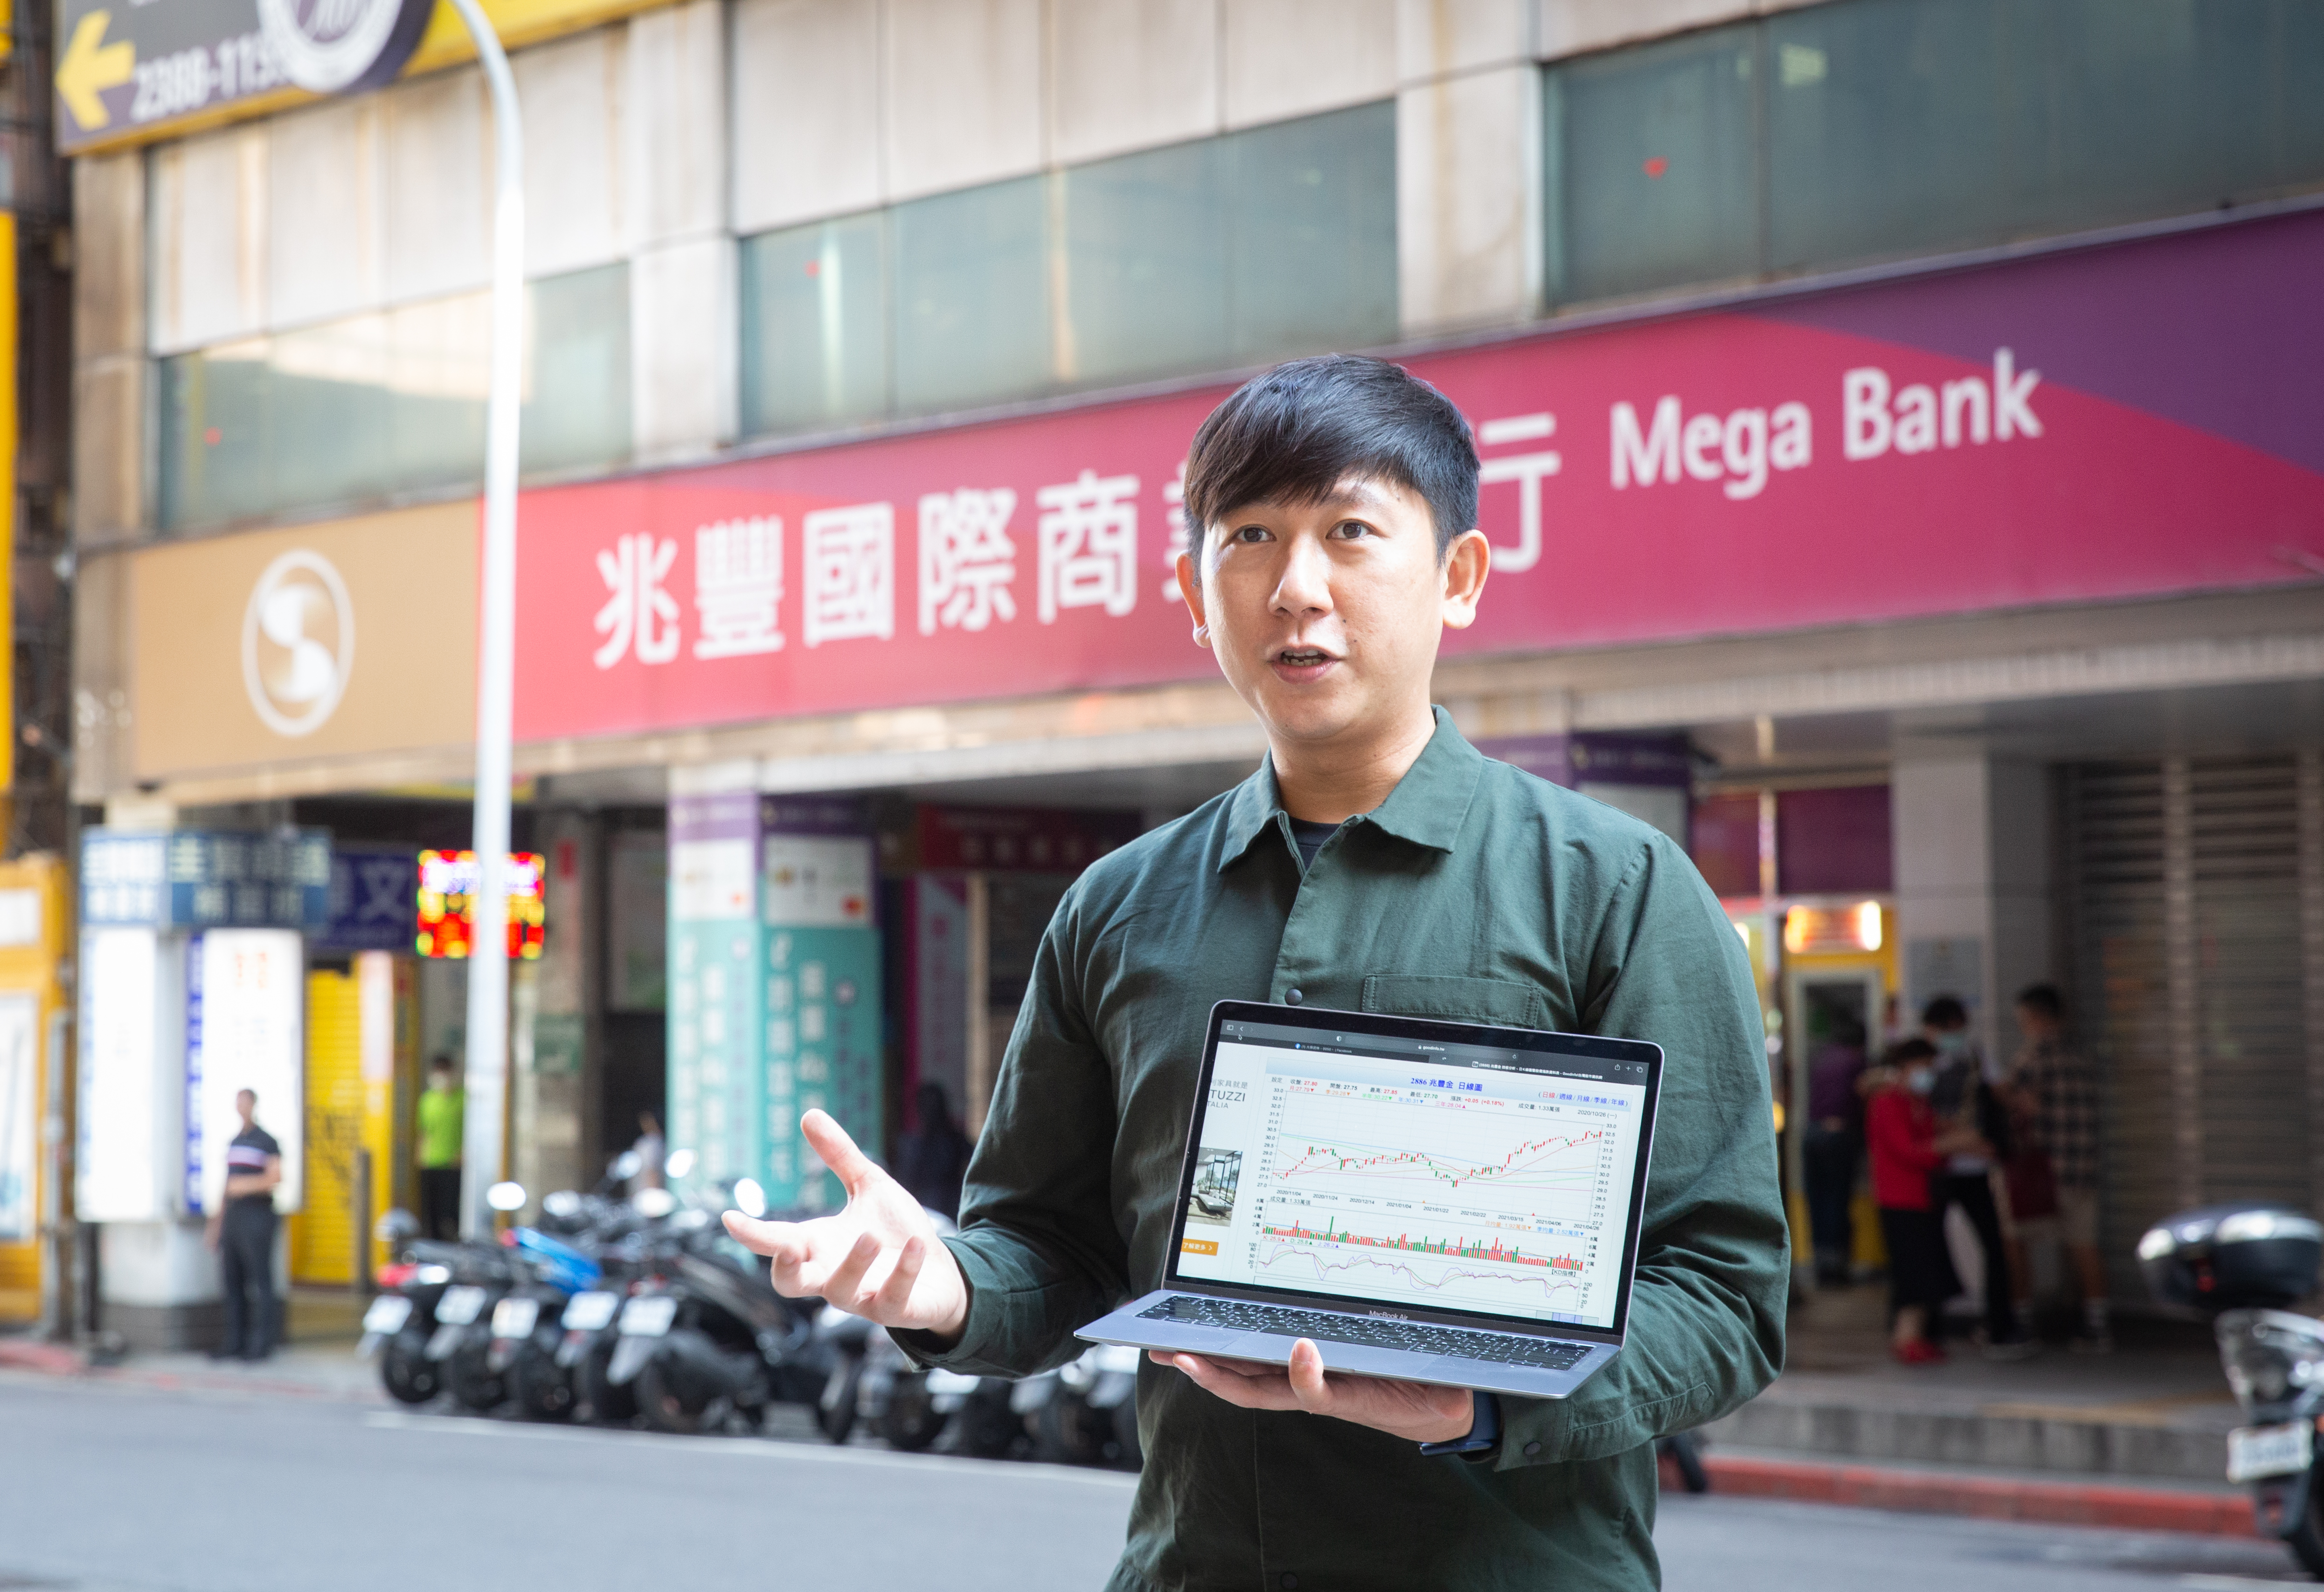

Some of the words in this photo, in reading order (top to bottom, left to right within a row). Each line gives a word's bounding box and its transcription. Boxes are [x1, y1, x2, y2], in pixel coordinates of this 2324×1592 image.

[1610, 395, 1812, 500] Mega
[1844, 346, 2044, 461] Bank
[1429, 1079, 1453, 1089] 兆豐金
[1458, 1082, 1483, 1091] 日線圖
[1210, 1090, 1245, 1101] TUZZI
[1369, 1310, 1398, 1319] MacBook
